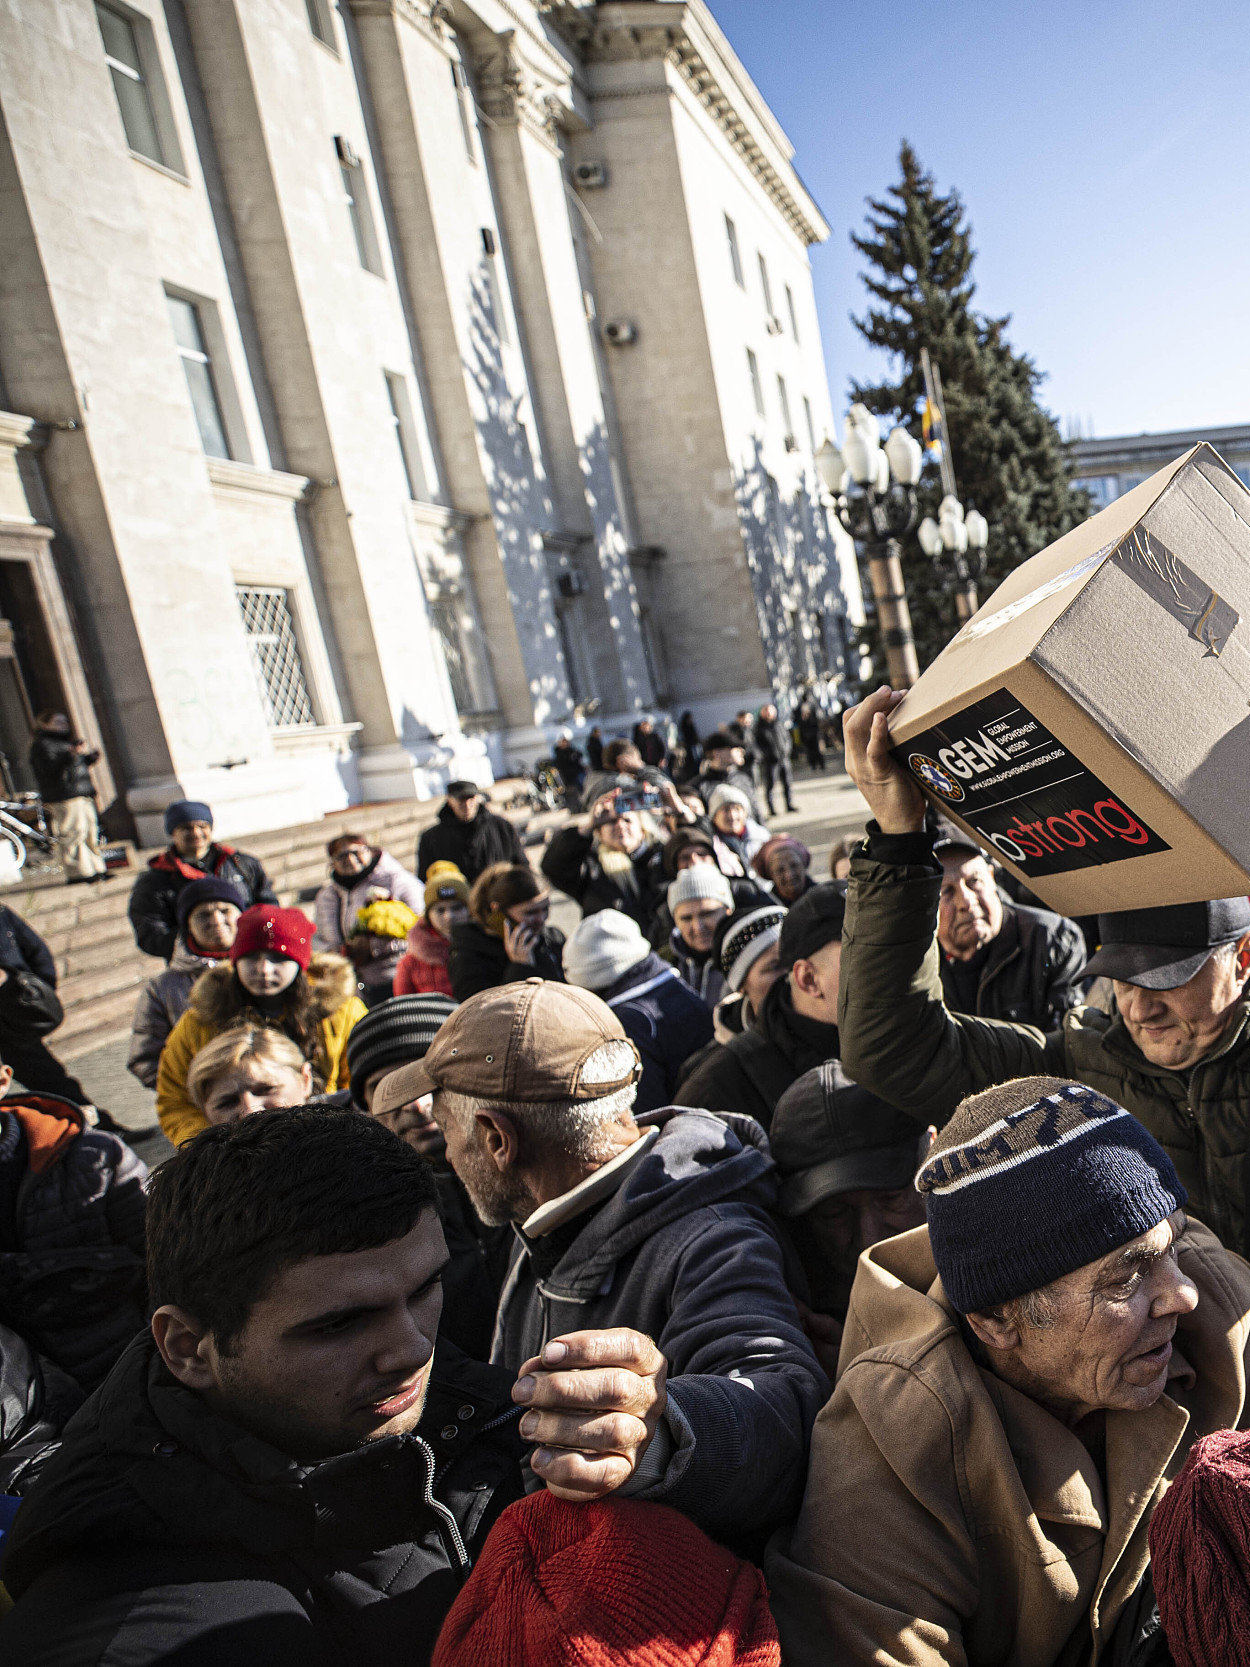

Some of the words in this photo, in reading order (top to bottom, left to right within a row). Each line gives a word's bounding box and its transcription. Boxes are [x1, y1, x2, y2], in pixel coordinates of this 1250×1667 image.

[987, 721, 1010, 736] GLOBAL
[995, 721, 1038, 745] EMPOWERMENT
[938, 729, 1012, 779] GEM
[1005, 739, 1030, 754] MISSION
[977, 798, 1148, 861] bstrong
